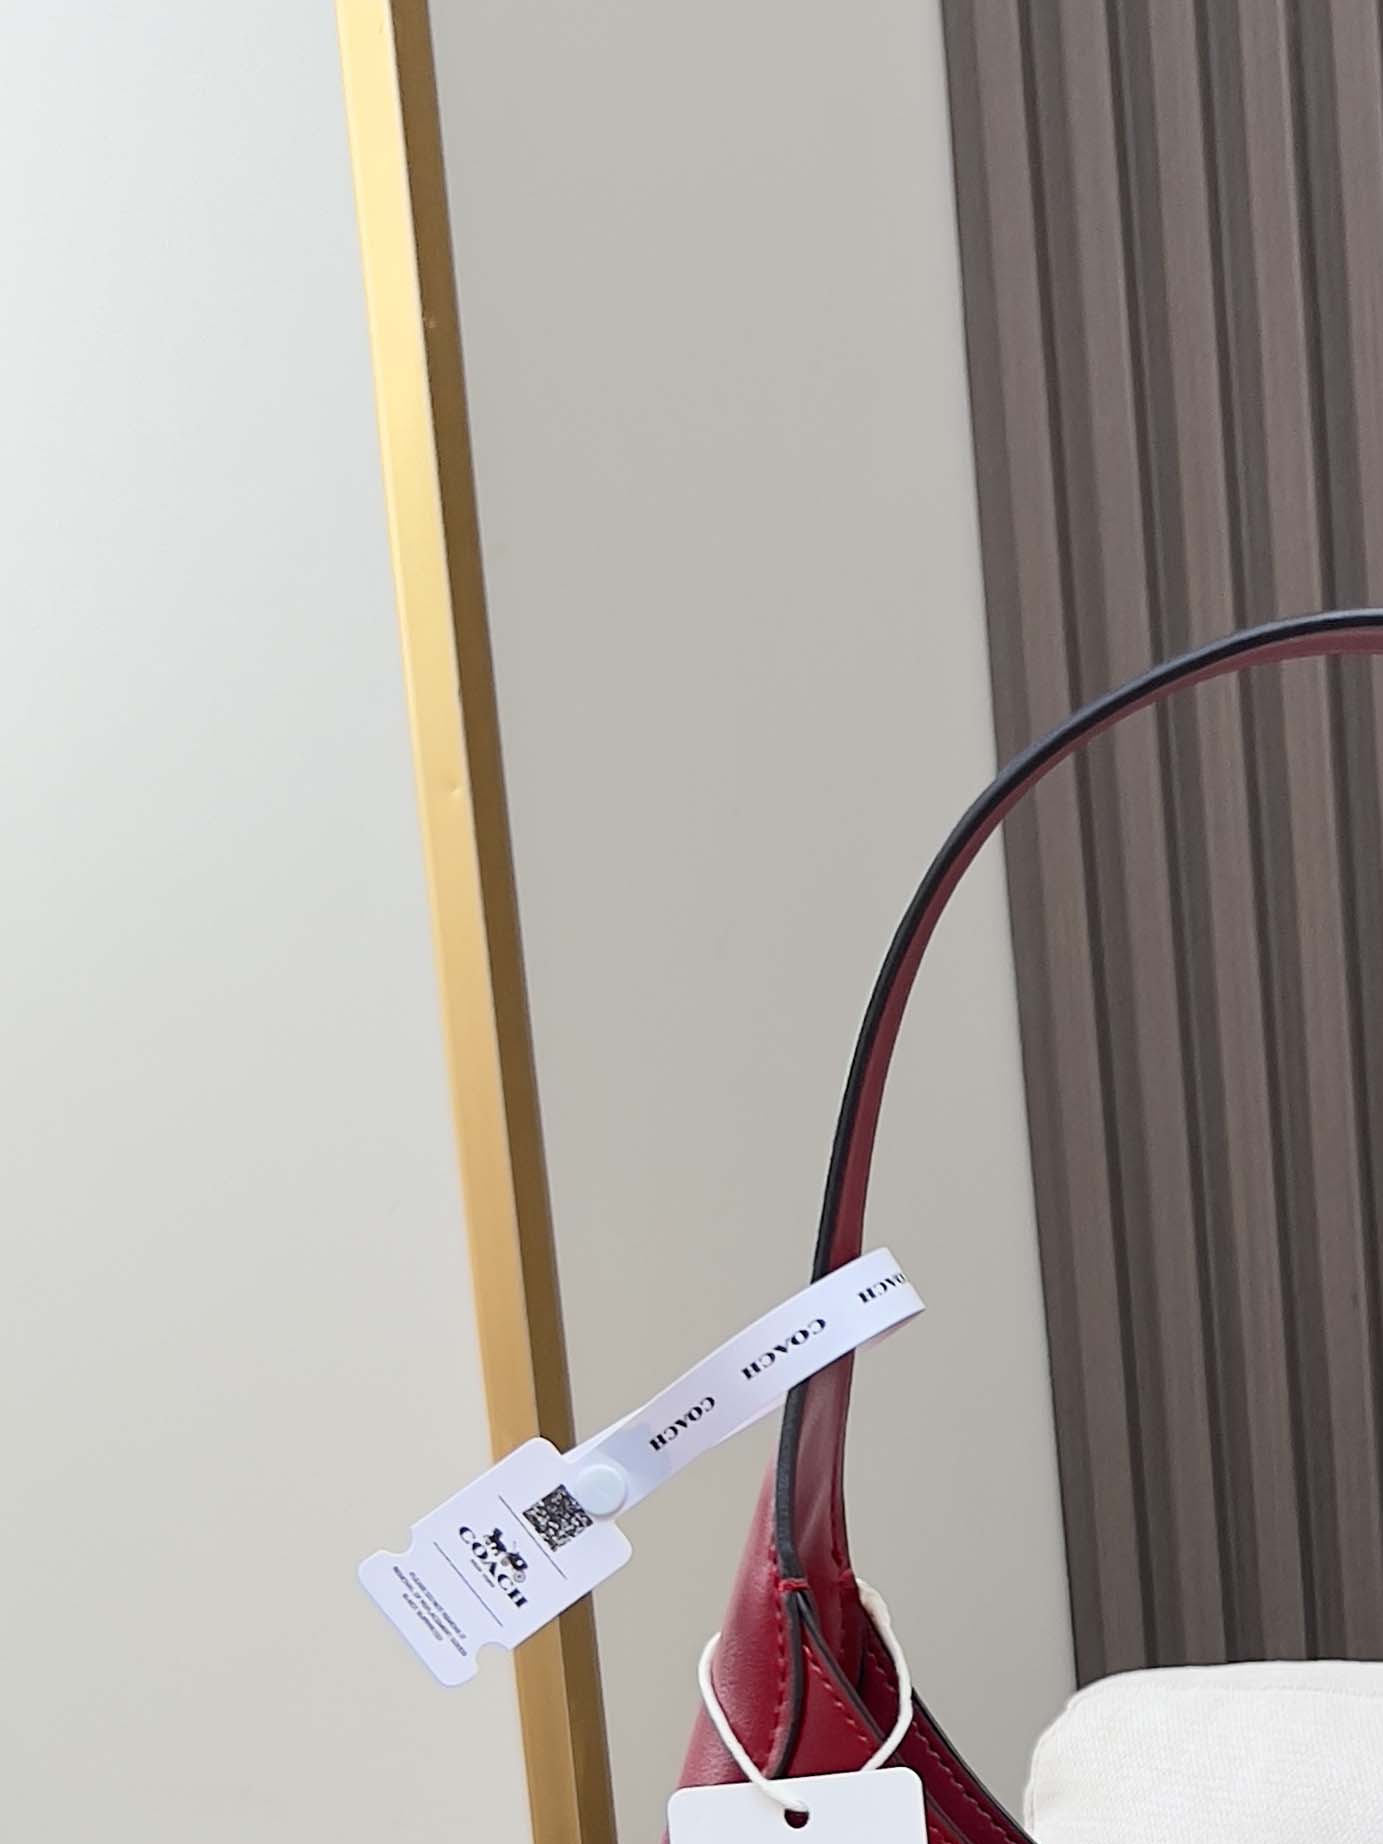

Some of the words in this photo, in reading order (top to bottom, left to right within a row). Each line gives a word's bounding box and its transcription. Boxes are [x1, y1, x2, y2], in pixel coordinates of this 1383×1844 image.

[741, 1318, 826, 1381] COACH
[649, 1396, 716, 1451] COACH
[459, 1526, 528, 1608] COACH
